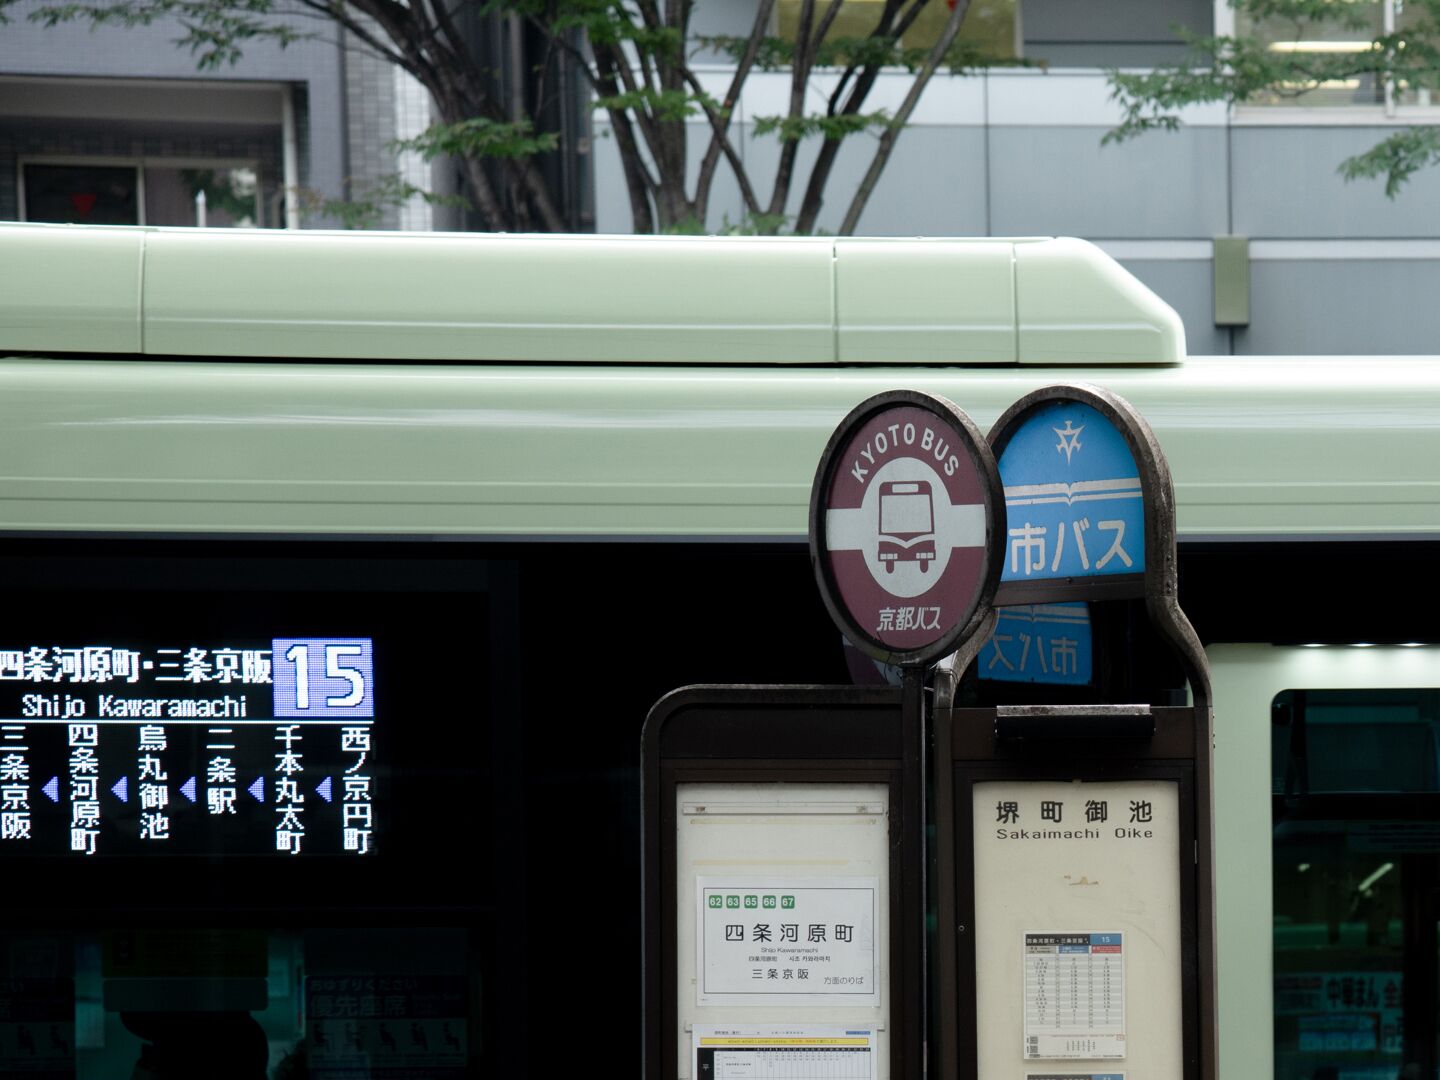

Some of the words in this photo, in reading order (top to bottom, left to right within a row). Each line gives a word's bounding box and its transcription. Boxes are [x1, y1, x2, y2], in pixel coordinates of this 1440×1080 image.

[851, 422, 915, 484] KYOTO
[921, 427, 960, 477] BUS
[1008, 517, 1133, 575] 市バス
[876, 606, 941, 631] 京都バス
[0, 646, 272, 683] 四条河原町・三条京阪
[285, 643, 366, 709] 15
[22, 695, 85, 718] Shijo
[99, 695, 247, 717] Kawaramachi
[0, 725, 31, 839] 三条京阪
[68, 724, 100, 854] 四条河原町
[138, 724, 171, 840] 烏丸御池
[206, 728, 237, 815] 二条駅
[274, 725, 305, 855] 千本丸太町
[341, 726, 372, 855] 西ノ京円町
[995, 800, 1153, 824] 堺町御池
[996, 828, 1100, 840] Sakaimachi
[1114, 828, 1153, 839] Oike
[725, 923, 854, 943] 四条河原町
[751, 968, 810, 980] 三条京阪
[823, 976, 865, 985] 方面のりば
